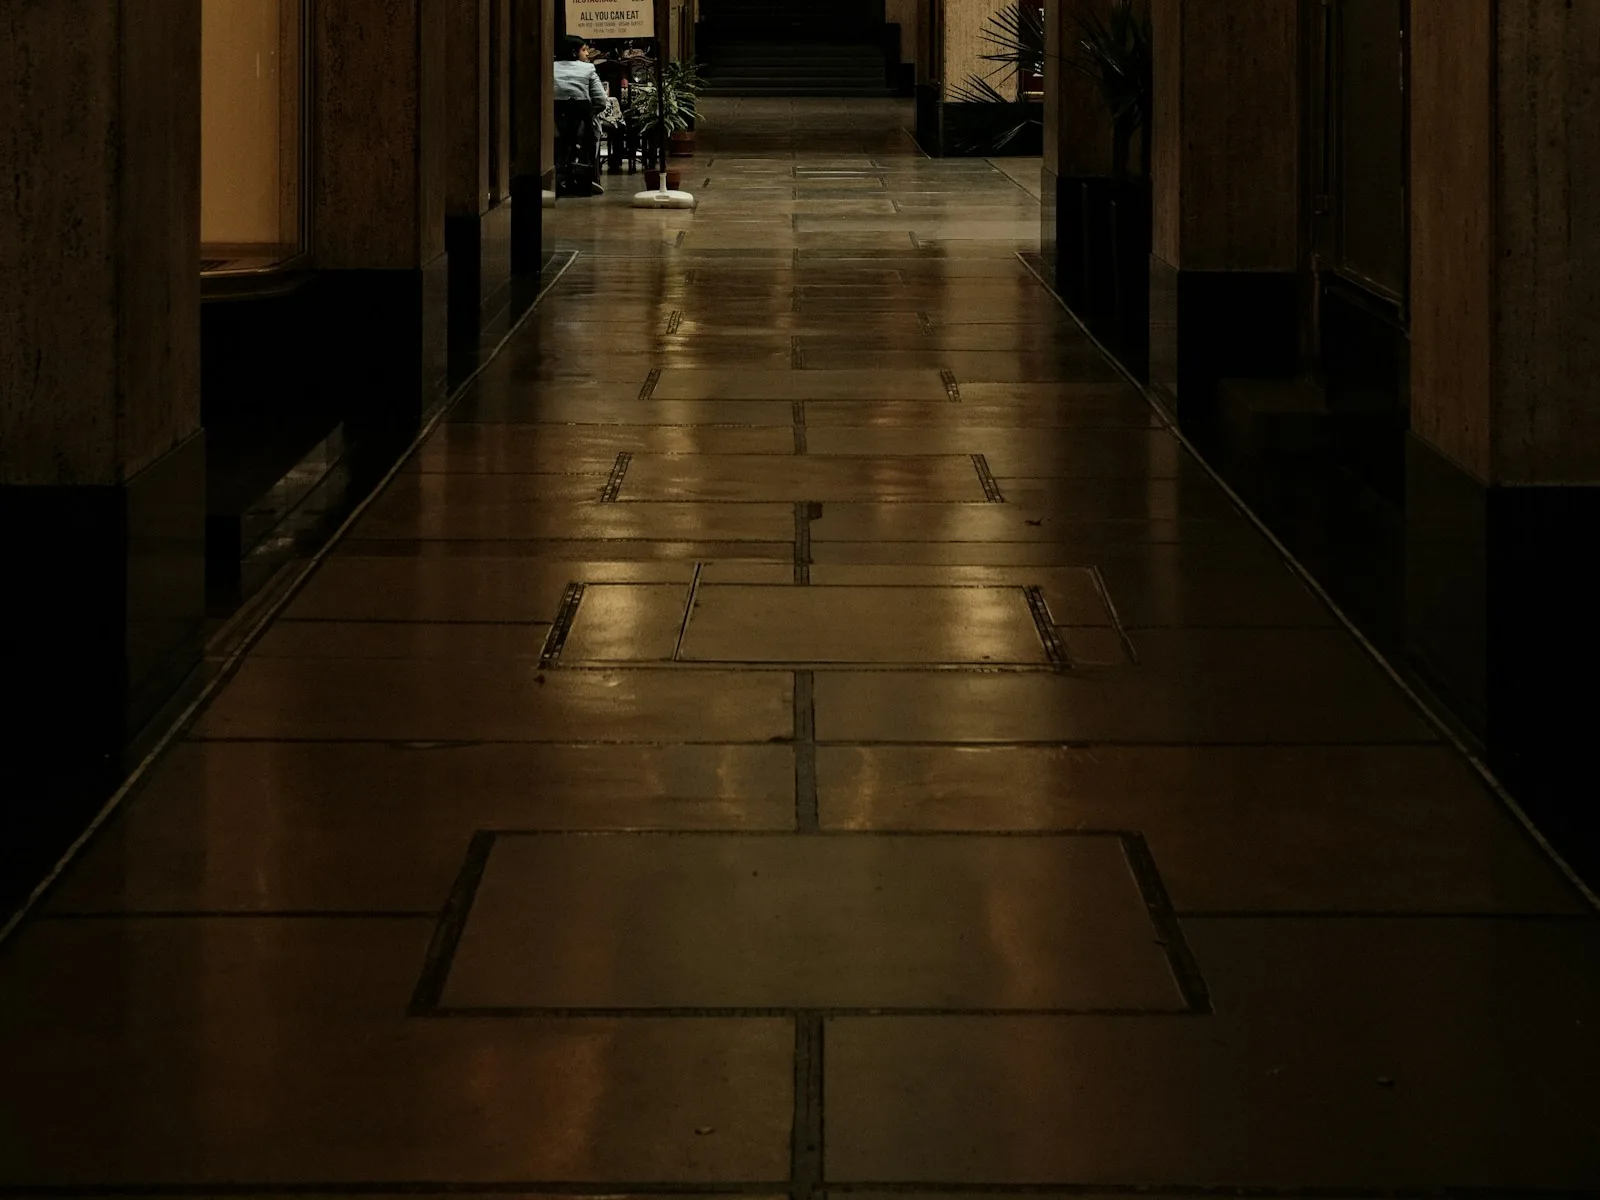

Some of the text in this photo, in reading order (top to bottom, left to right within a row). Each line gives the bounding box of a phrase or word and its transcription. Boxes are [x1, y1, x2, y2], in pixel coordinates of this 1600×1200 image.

[580, 10, 639, 21] ALL YOU CAN EAT
